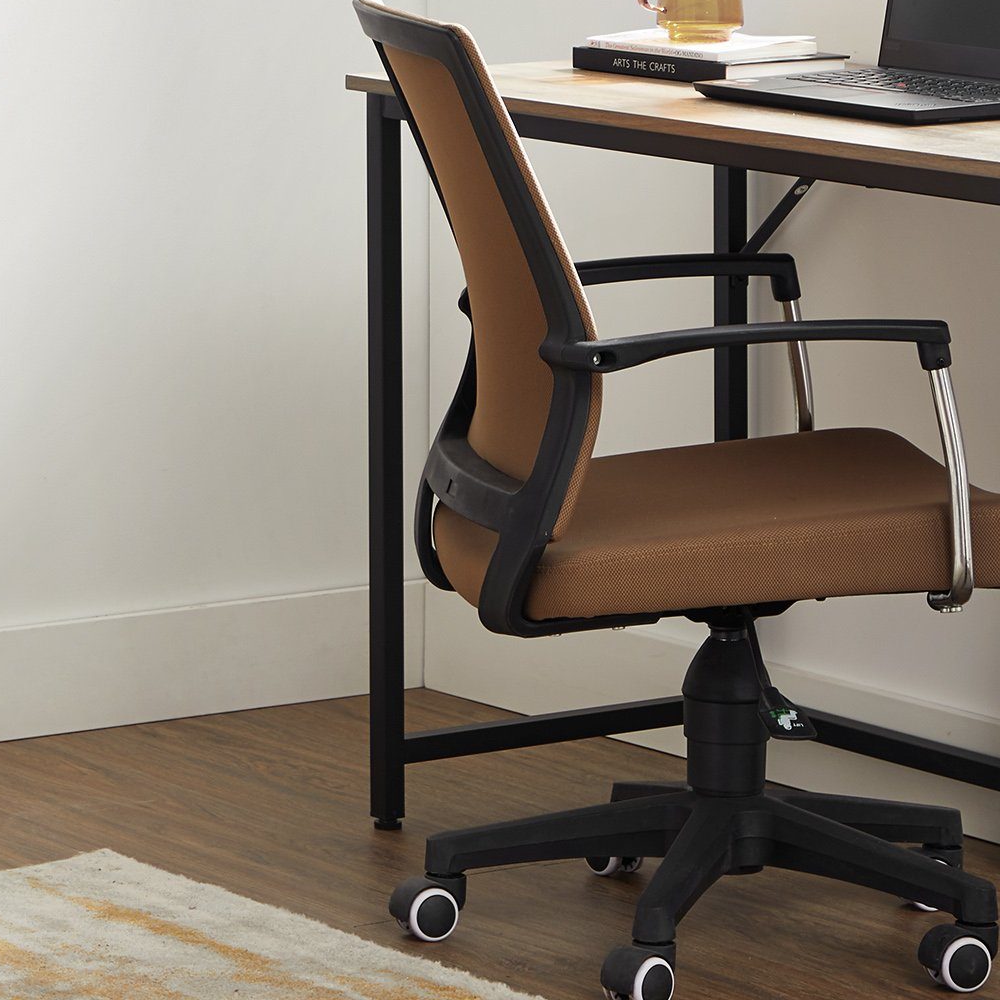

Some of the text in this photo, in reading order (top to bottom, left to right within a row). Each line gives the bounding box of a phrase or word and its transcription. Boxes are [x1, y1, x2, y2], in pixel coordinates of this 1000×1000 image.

[612, 58, 676, 74] ARTS THE CRAFTS
